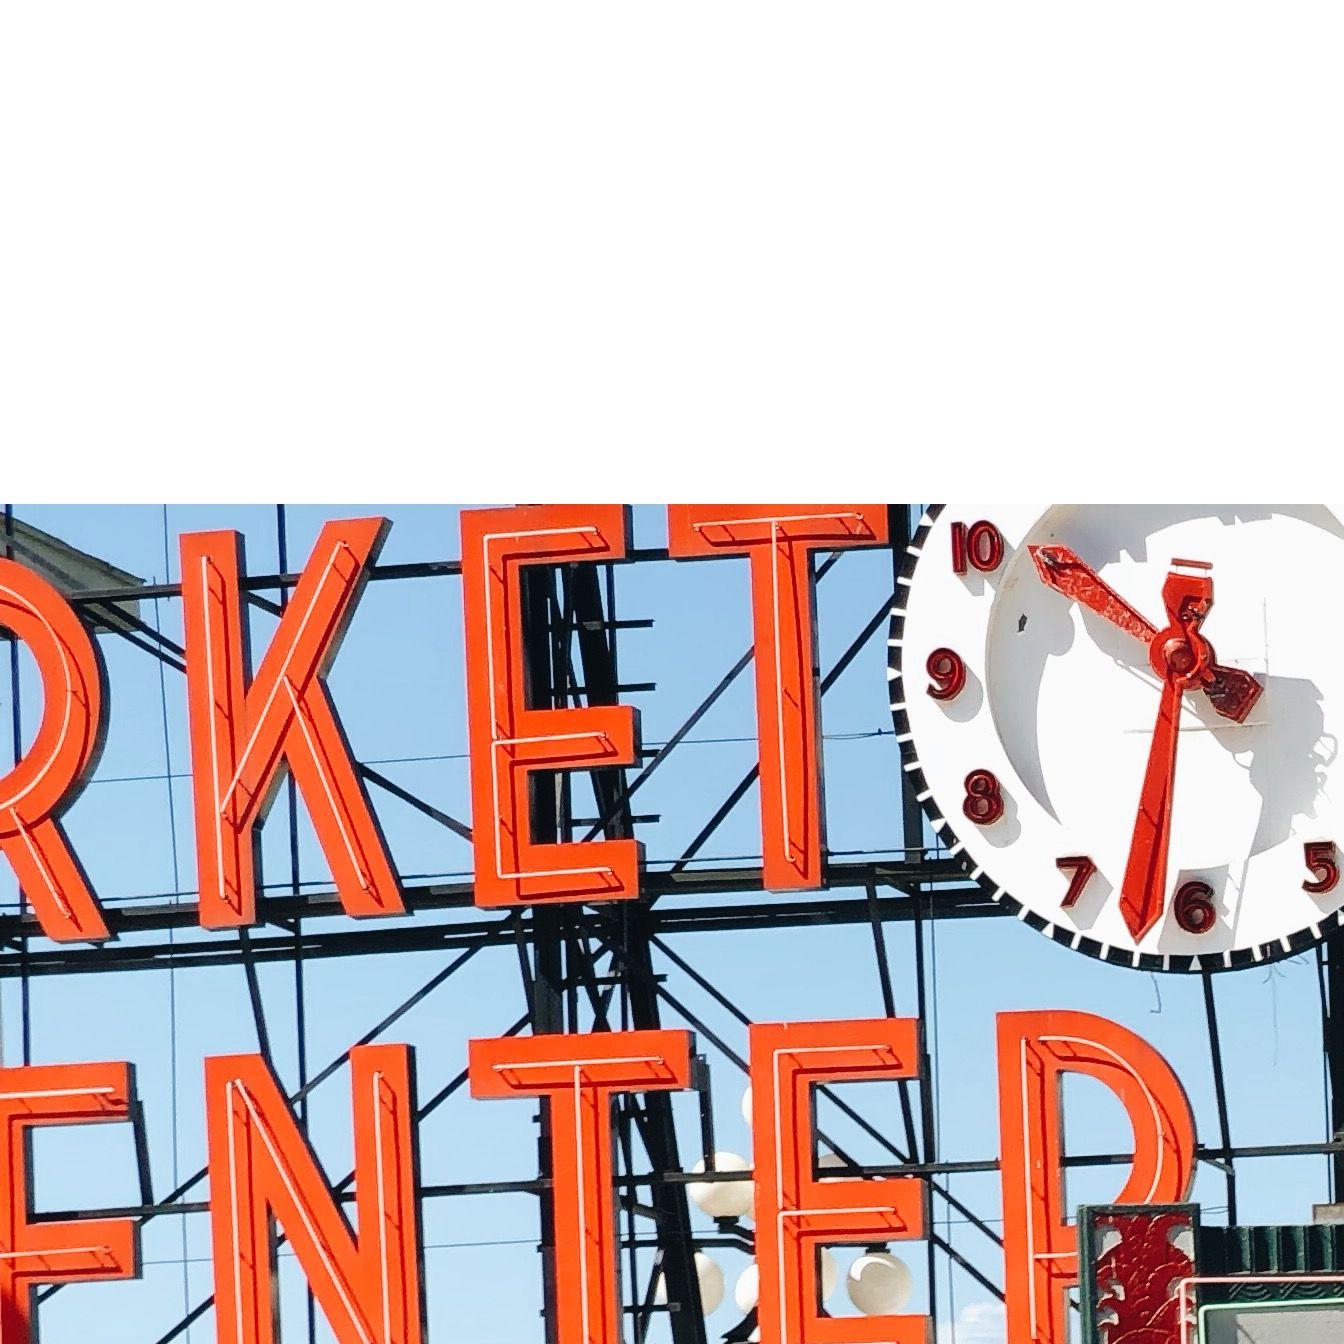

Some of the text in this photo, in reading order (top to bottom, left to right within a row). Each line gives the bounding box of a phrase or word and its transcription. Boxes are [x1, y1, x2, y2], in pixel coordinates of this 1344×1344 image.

[951, 519, 1006, 577] 10
[925, 646, 967, 702] 9
[961, 768, 1005, 826] 8
[1056, 854, 1098, 908] 7
[1301, 840, 1341, 895] 5
[1172, 880, 1216, 935] 6
